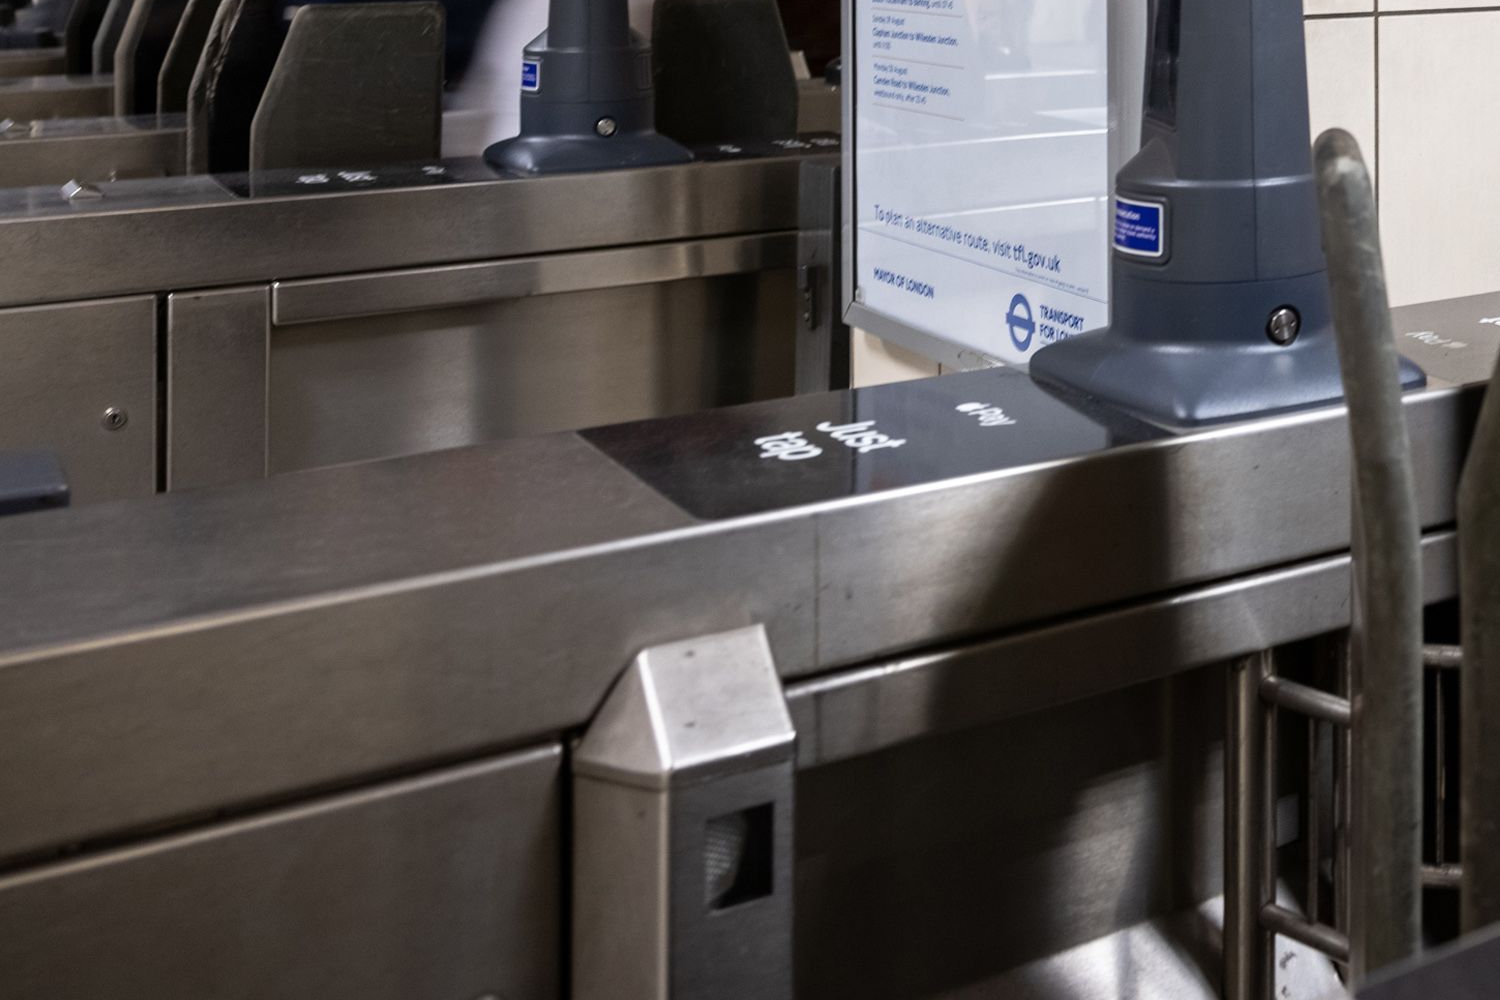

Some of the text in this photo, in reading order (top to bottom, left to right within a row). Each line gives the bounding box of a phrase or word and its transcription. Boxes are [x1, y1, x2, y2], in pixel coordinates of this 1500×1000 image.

[874, 204, 884, 220] To
[905, 215, 914, 230] an
[916, 216, 960, 244] alternative
[962, 231, 989, 254] route,
[993, 237, 1011, 258] visit
[1013, 242, 1060, 277] tfl.gov.uk
[873, 266, 934, 300] MAYOR OF LONDON
[1040, 304, 1083, 331] TRANSPORT
[1040, 324, 1055, 341] FOR
[973, 403, 1017, 427] Pay
[753, 431, 823, 461] tap
[816, 419, 907, 454] Just
